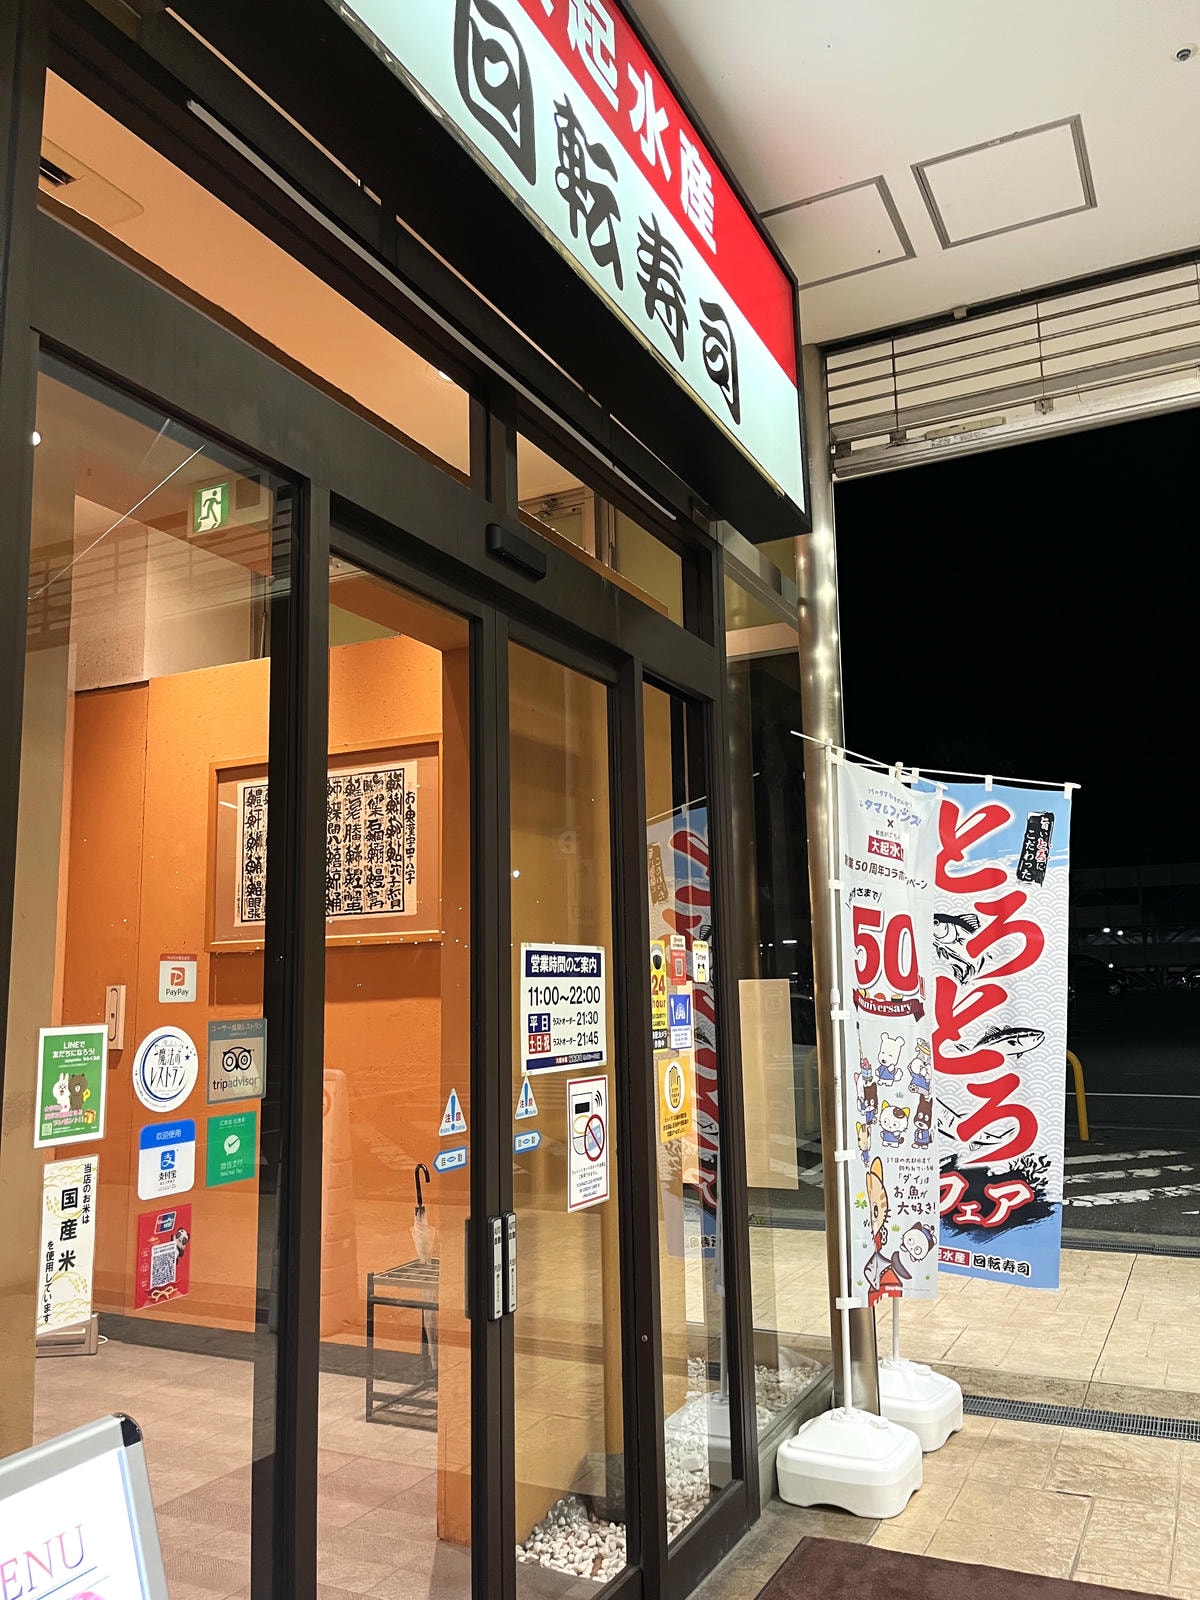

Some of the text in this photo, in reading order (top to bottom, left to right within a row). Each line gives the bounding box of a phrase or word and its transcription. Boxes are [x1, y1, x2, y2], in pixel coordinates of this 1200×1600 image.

[535, 0, 717, 255] 起水産
[454, 0, 741, 425] 回転寿司
[1021, 830, 1036, 880] こだわった
[1035, 817, 1050, 872] 旨いとろに
[853, 905, 919, 992] 50
[530, 954, 597, 974] 営業時間のご案内
[165, 988, 189, 997] PayPay
[651, 975, 665, 996] 24
[933, 799, 1045, 1166] とろとろ
[530, 1011, 599, 1032] 平日 ラストオーダー 21:30
[63, 1041, 86, 1049] LINEで
[553, 1038, 576, 1046] ラストオーダー
[577, 1031, 599, 1046] 21:45
[157, 1048, 181, 1065] 魔法の
[150, 1066, 186, 1088] レストラン
[213, 1076, 258, 1091] tripadvisor
[156, 1129, 181, 1140] 欢迎使用
[158, 1170, 177, 1181] 支付宝
[82, 1163, 92, 1225] 当店のお米は
[894, 1186, 927, 1200] お魚が
[940, 1173, 1033, 1227] フェア
[58, 1187, 79, 1272] 国産米
[973, 1255, 1030, 1276] 回転寿司
[43, 1241, 54, 1324] を使用しています
[0, 1523, 84, 1600] ENU
